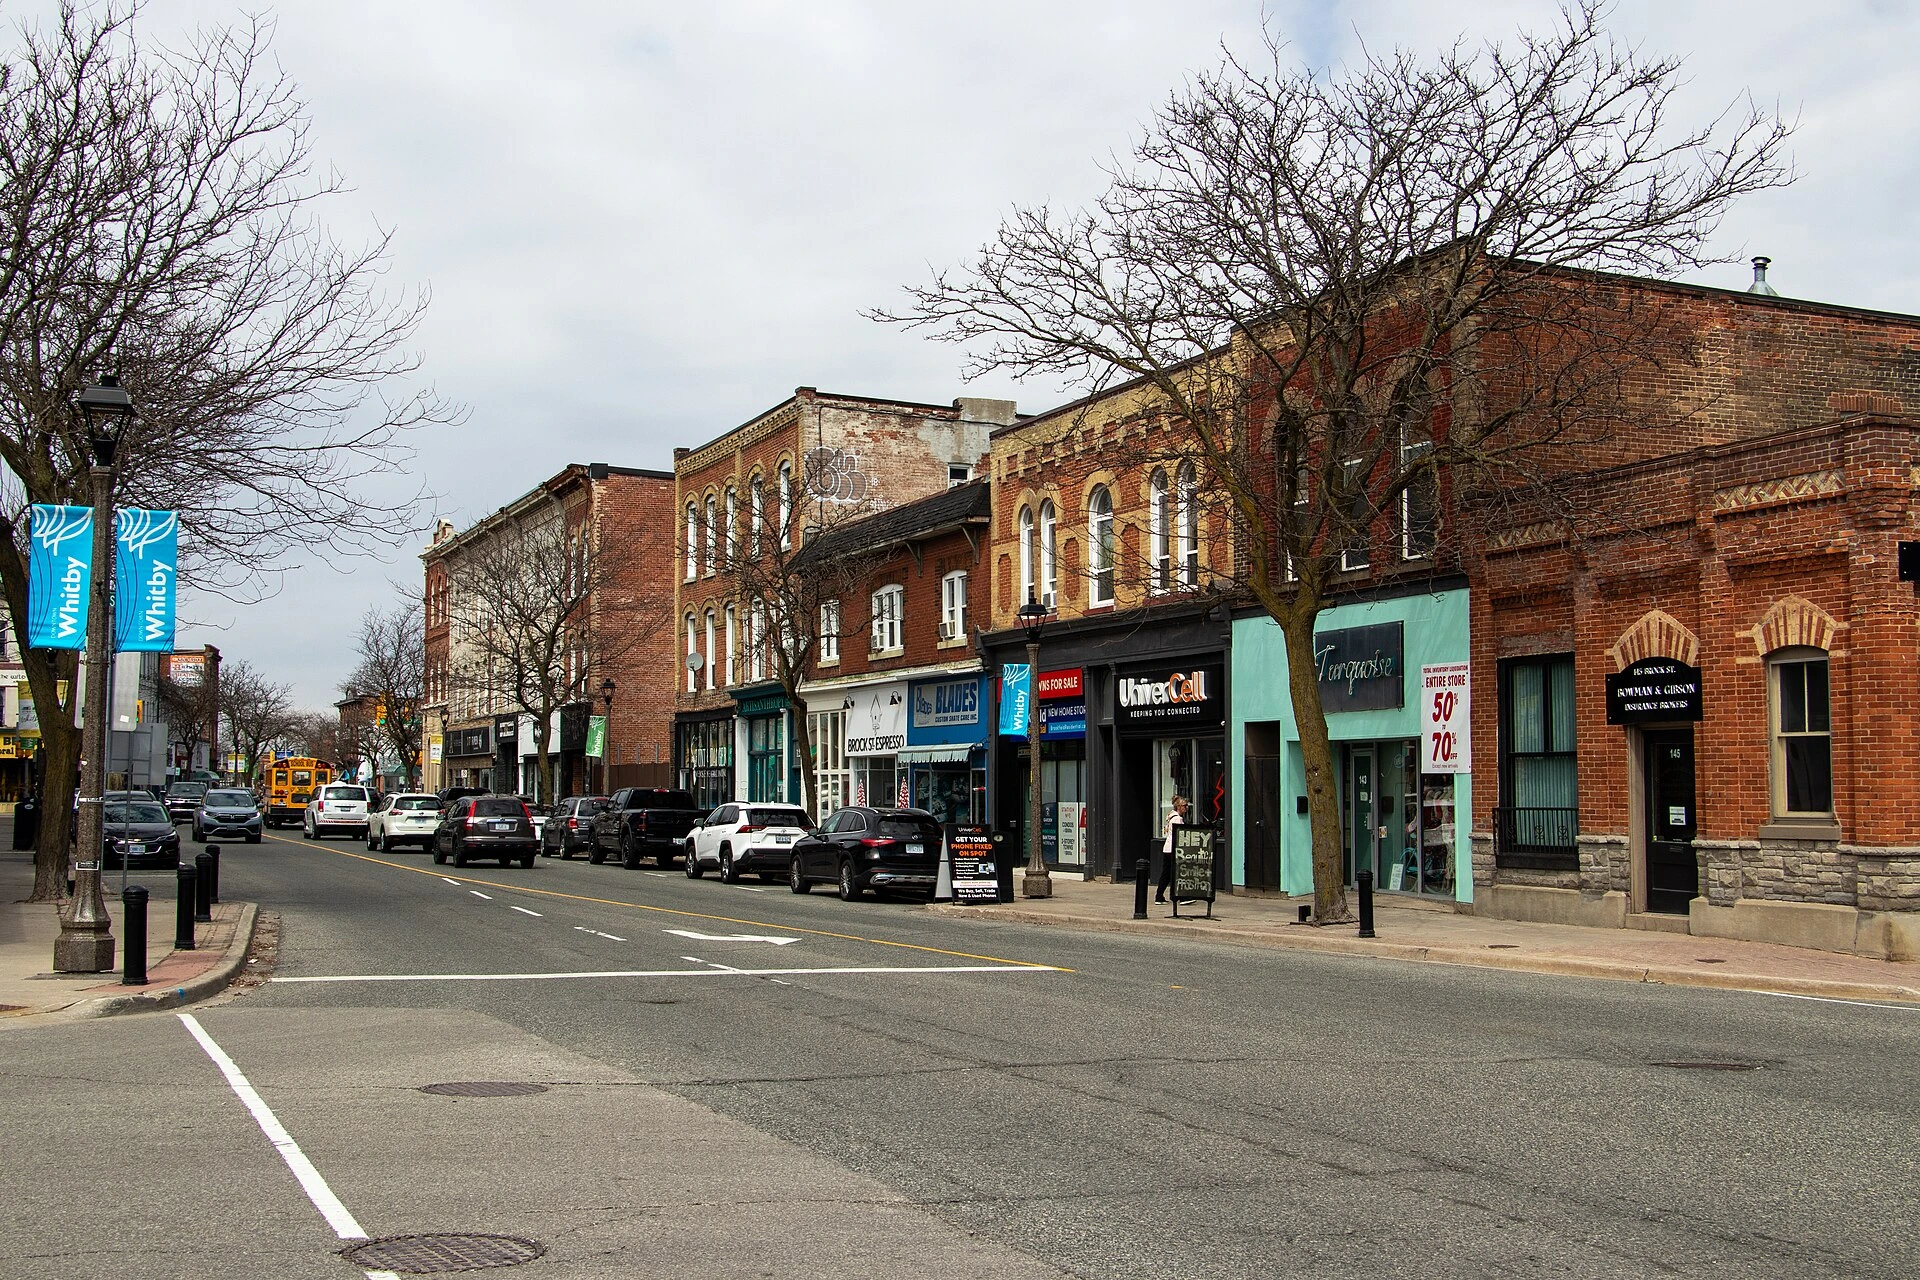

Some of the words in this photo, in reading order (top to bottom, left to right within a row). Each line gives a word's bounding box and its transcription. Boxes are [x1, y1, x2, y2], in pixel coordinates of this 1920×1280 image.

[58, 556, 87, 639] Whitby
[145, 559, 173, 641] Whitby
[1315, 645, 1393, 696] Turquoise
[1634, 668, 1643, 676] 145
[1644, 666, 1665, 675] BROCK
[1665, 665, 1677, 674] ST.
[1051, 678, 1063, 690] FOR
[1063, 676, 1078, 689] SALE
[1426, 675, 1447, 688] ENTIRE
[1447, 674, 1466, 687] STORE
[1119, 671, 1208, 708] UniverCell
[1617, 686, 1653, 697] BOWMAN
[1654, 685, 1662, 695] &
[1664, 683, 1695, 694] GIBSON
[936, 682, 977, 714] BLADES
[1624, 702, 1658, 711] INSURANCE
[1659, 700, 1689, 709] BROKERS
[1012, 689, 1028, 731] Whitby
[1048, 707, 1059, 718] NEW
[1059, 706, 1074, 717] HOME
[1130, 709, 1153, 718] KEEPING
[1154, 708, 1165, 716] YOU
[1166, 706, 1201, 715] CONNECTED
[594, 730, 604, 755] Whitby
[848, 737, 869, 753] BROCK
[875, 734, 905, 751] ESPRESSO
[1670, 749, 1681, 759] 145
[291, 760, 305, 768] SCHOOL
[306, 760, 314, 768] BUS
[1178, 830, 1212, 848] HEY
